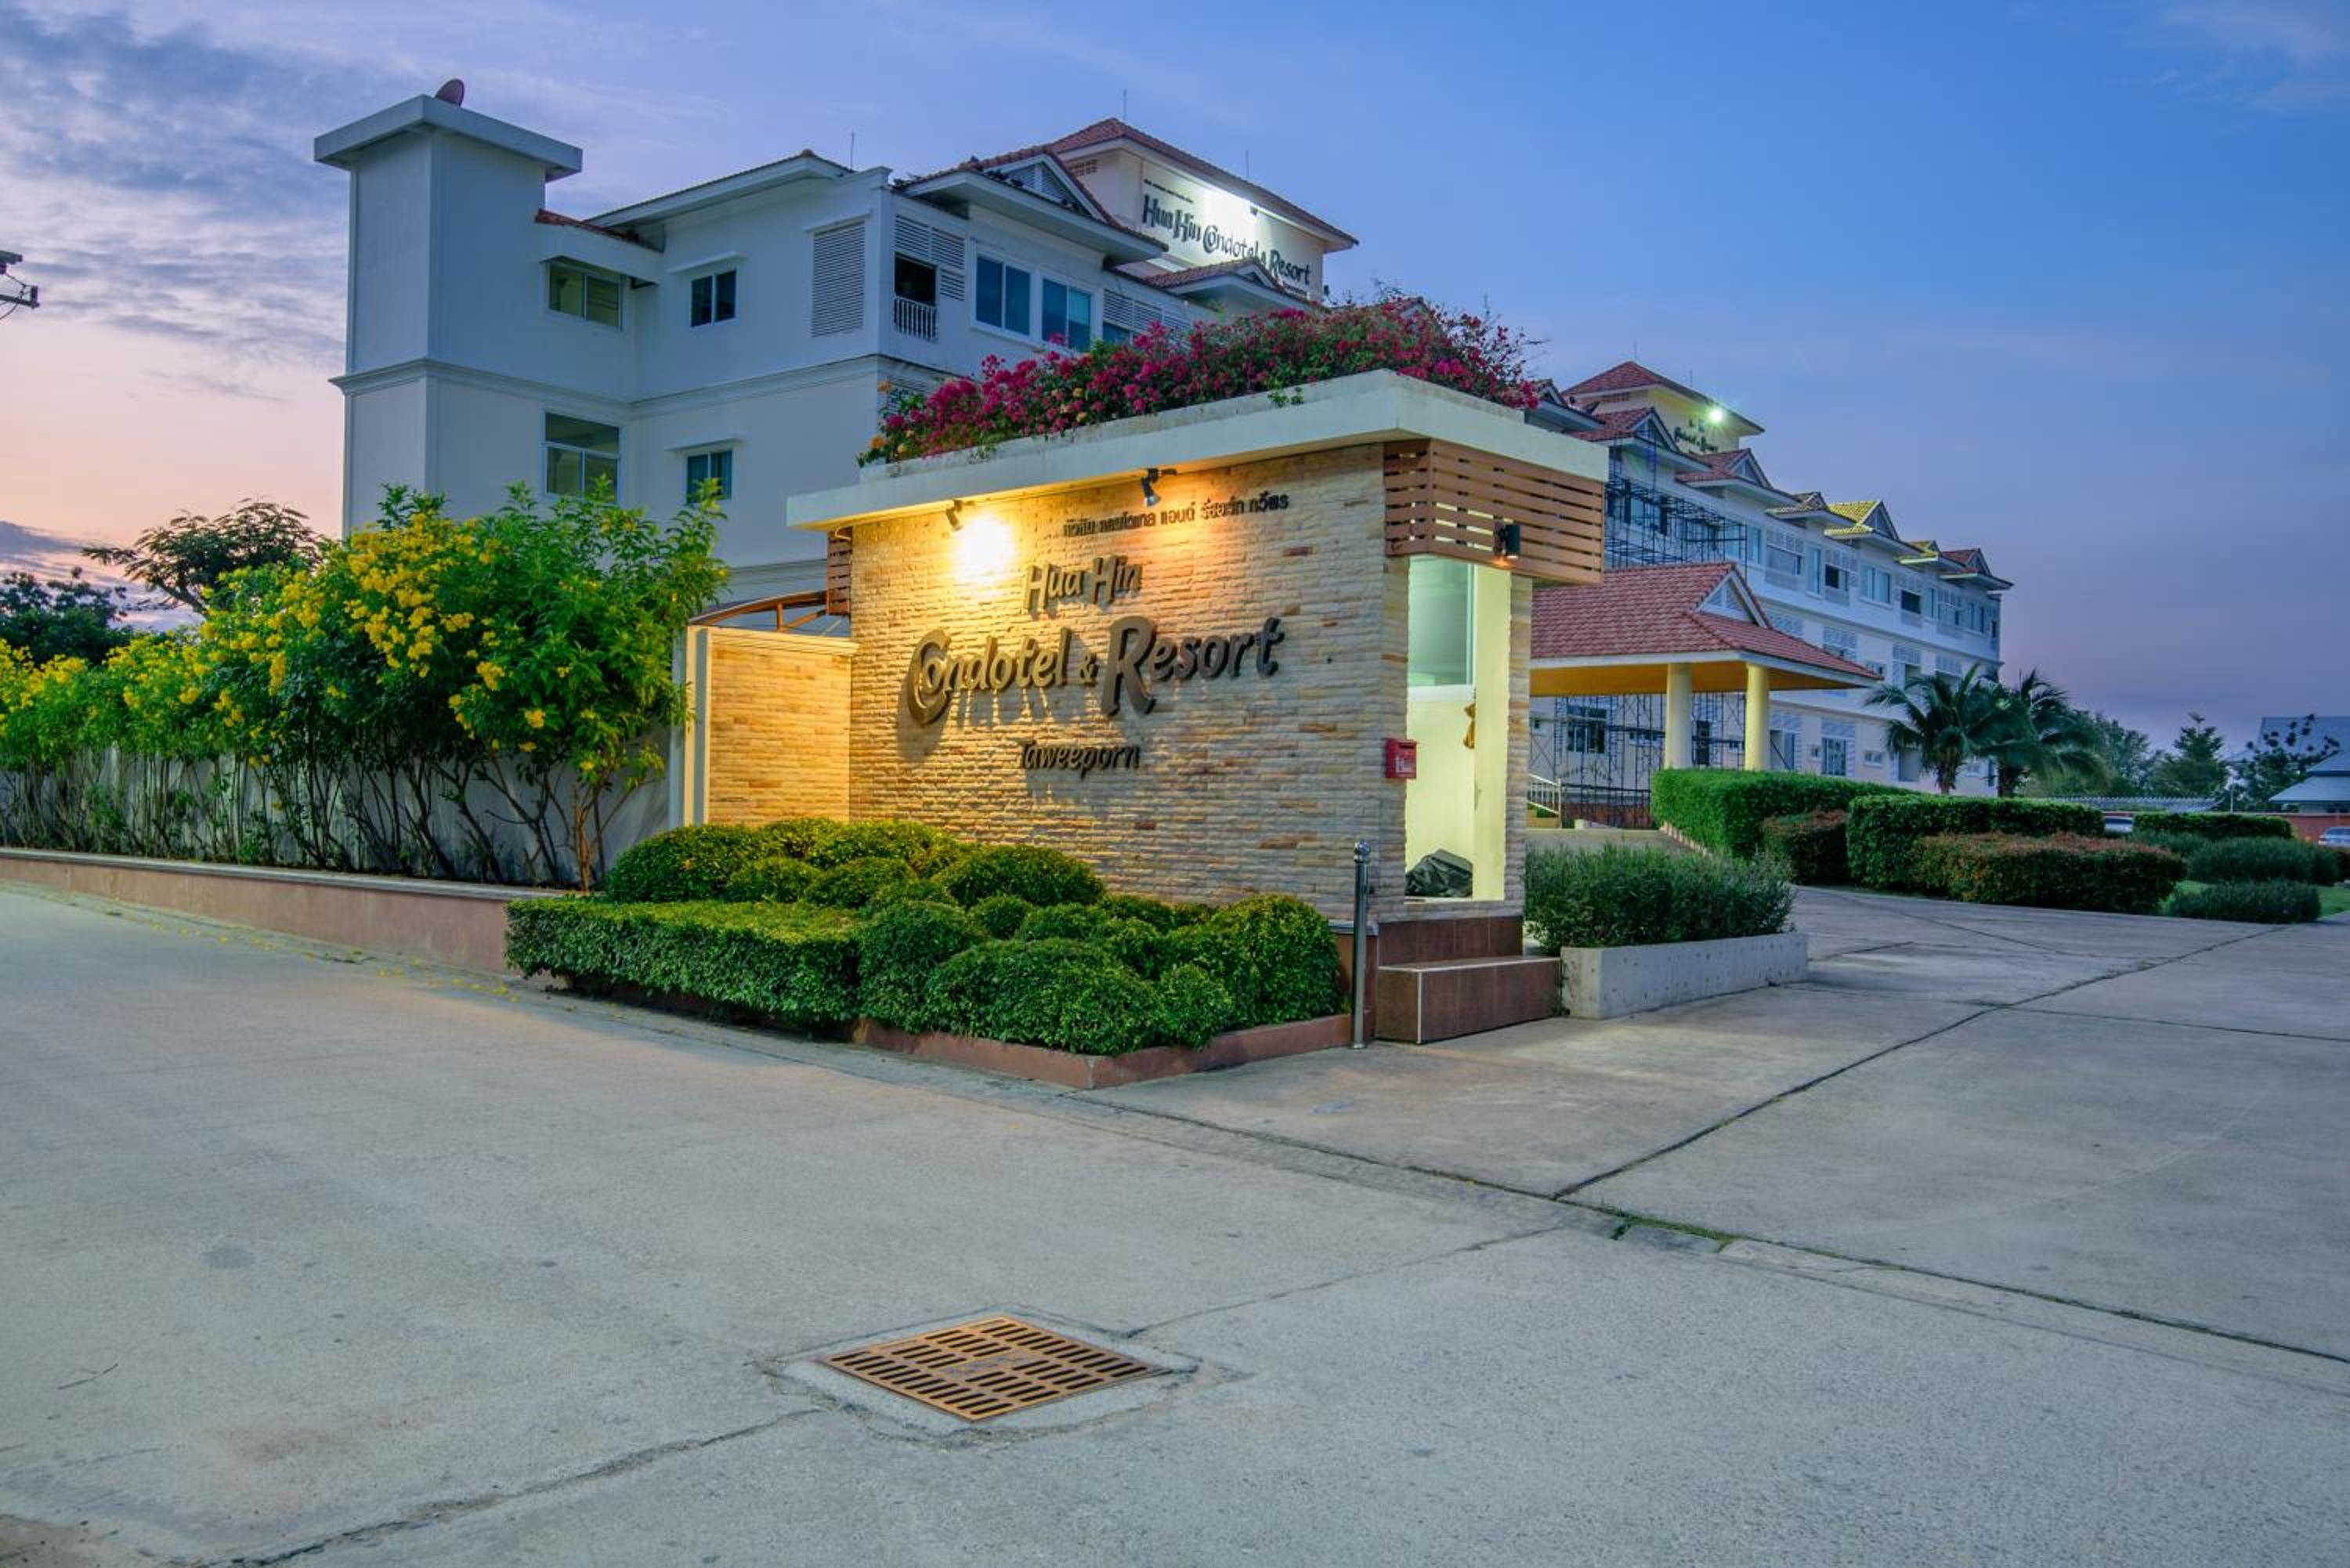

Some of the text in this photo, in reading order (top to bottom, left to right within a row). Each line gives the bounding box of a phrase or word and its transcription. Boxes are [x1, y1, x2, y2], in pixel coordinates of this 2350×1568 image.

[1141, 194, 1173, 229] Hua
[1173, 209, 1201, 242] Hin
[1269, 250, 1310, 284] Resort
[1023, 555, 1143, 612] Hua Hin
[907, 616, 1285, 727] Condotel & Resort
[1022, 740, 1140, 779] Taweeporn
